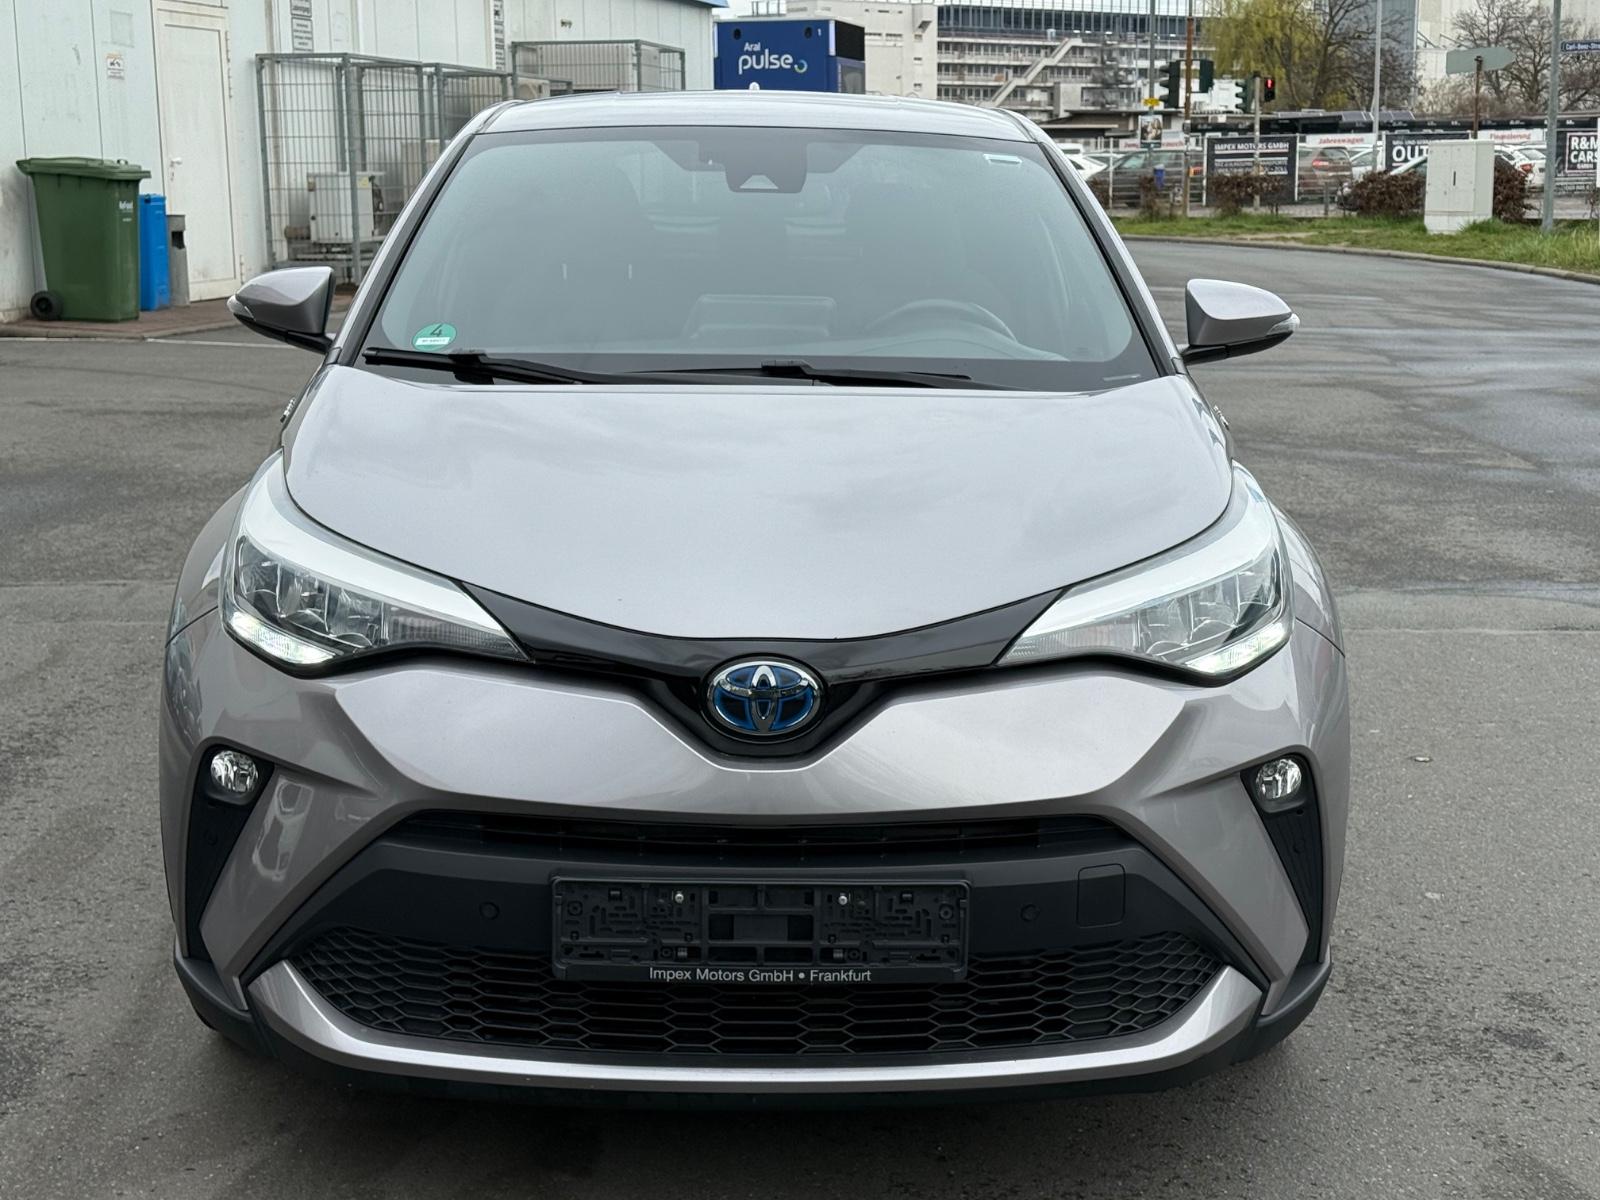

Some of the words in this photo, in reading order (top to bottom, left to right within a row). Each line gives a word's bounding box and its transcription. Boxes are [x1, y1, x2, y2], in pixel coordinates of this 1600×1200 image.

[744, 42, 761, 51] Aral
[738, 48, 794, 75] pulse
[430, 323, 443, 337] 4
[649, 967, 692, 982] Impex
[696, 968, 745, 981] Motors
[748, 969, 794, 982] GmbH
[810, 969, 871, 982] Frankfurt
